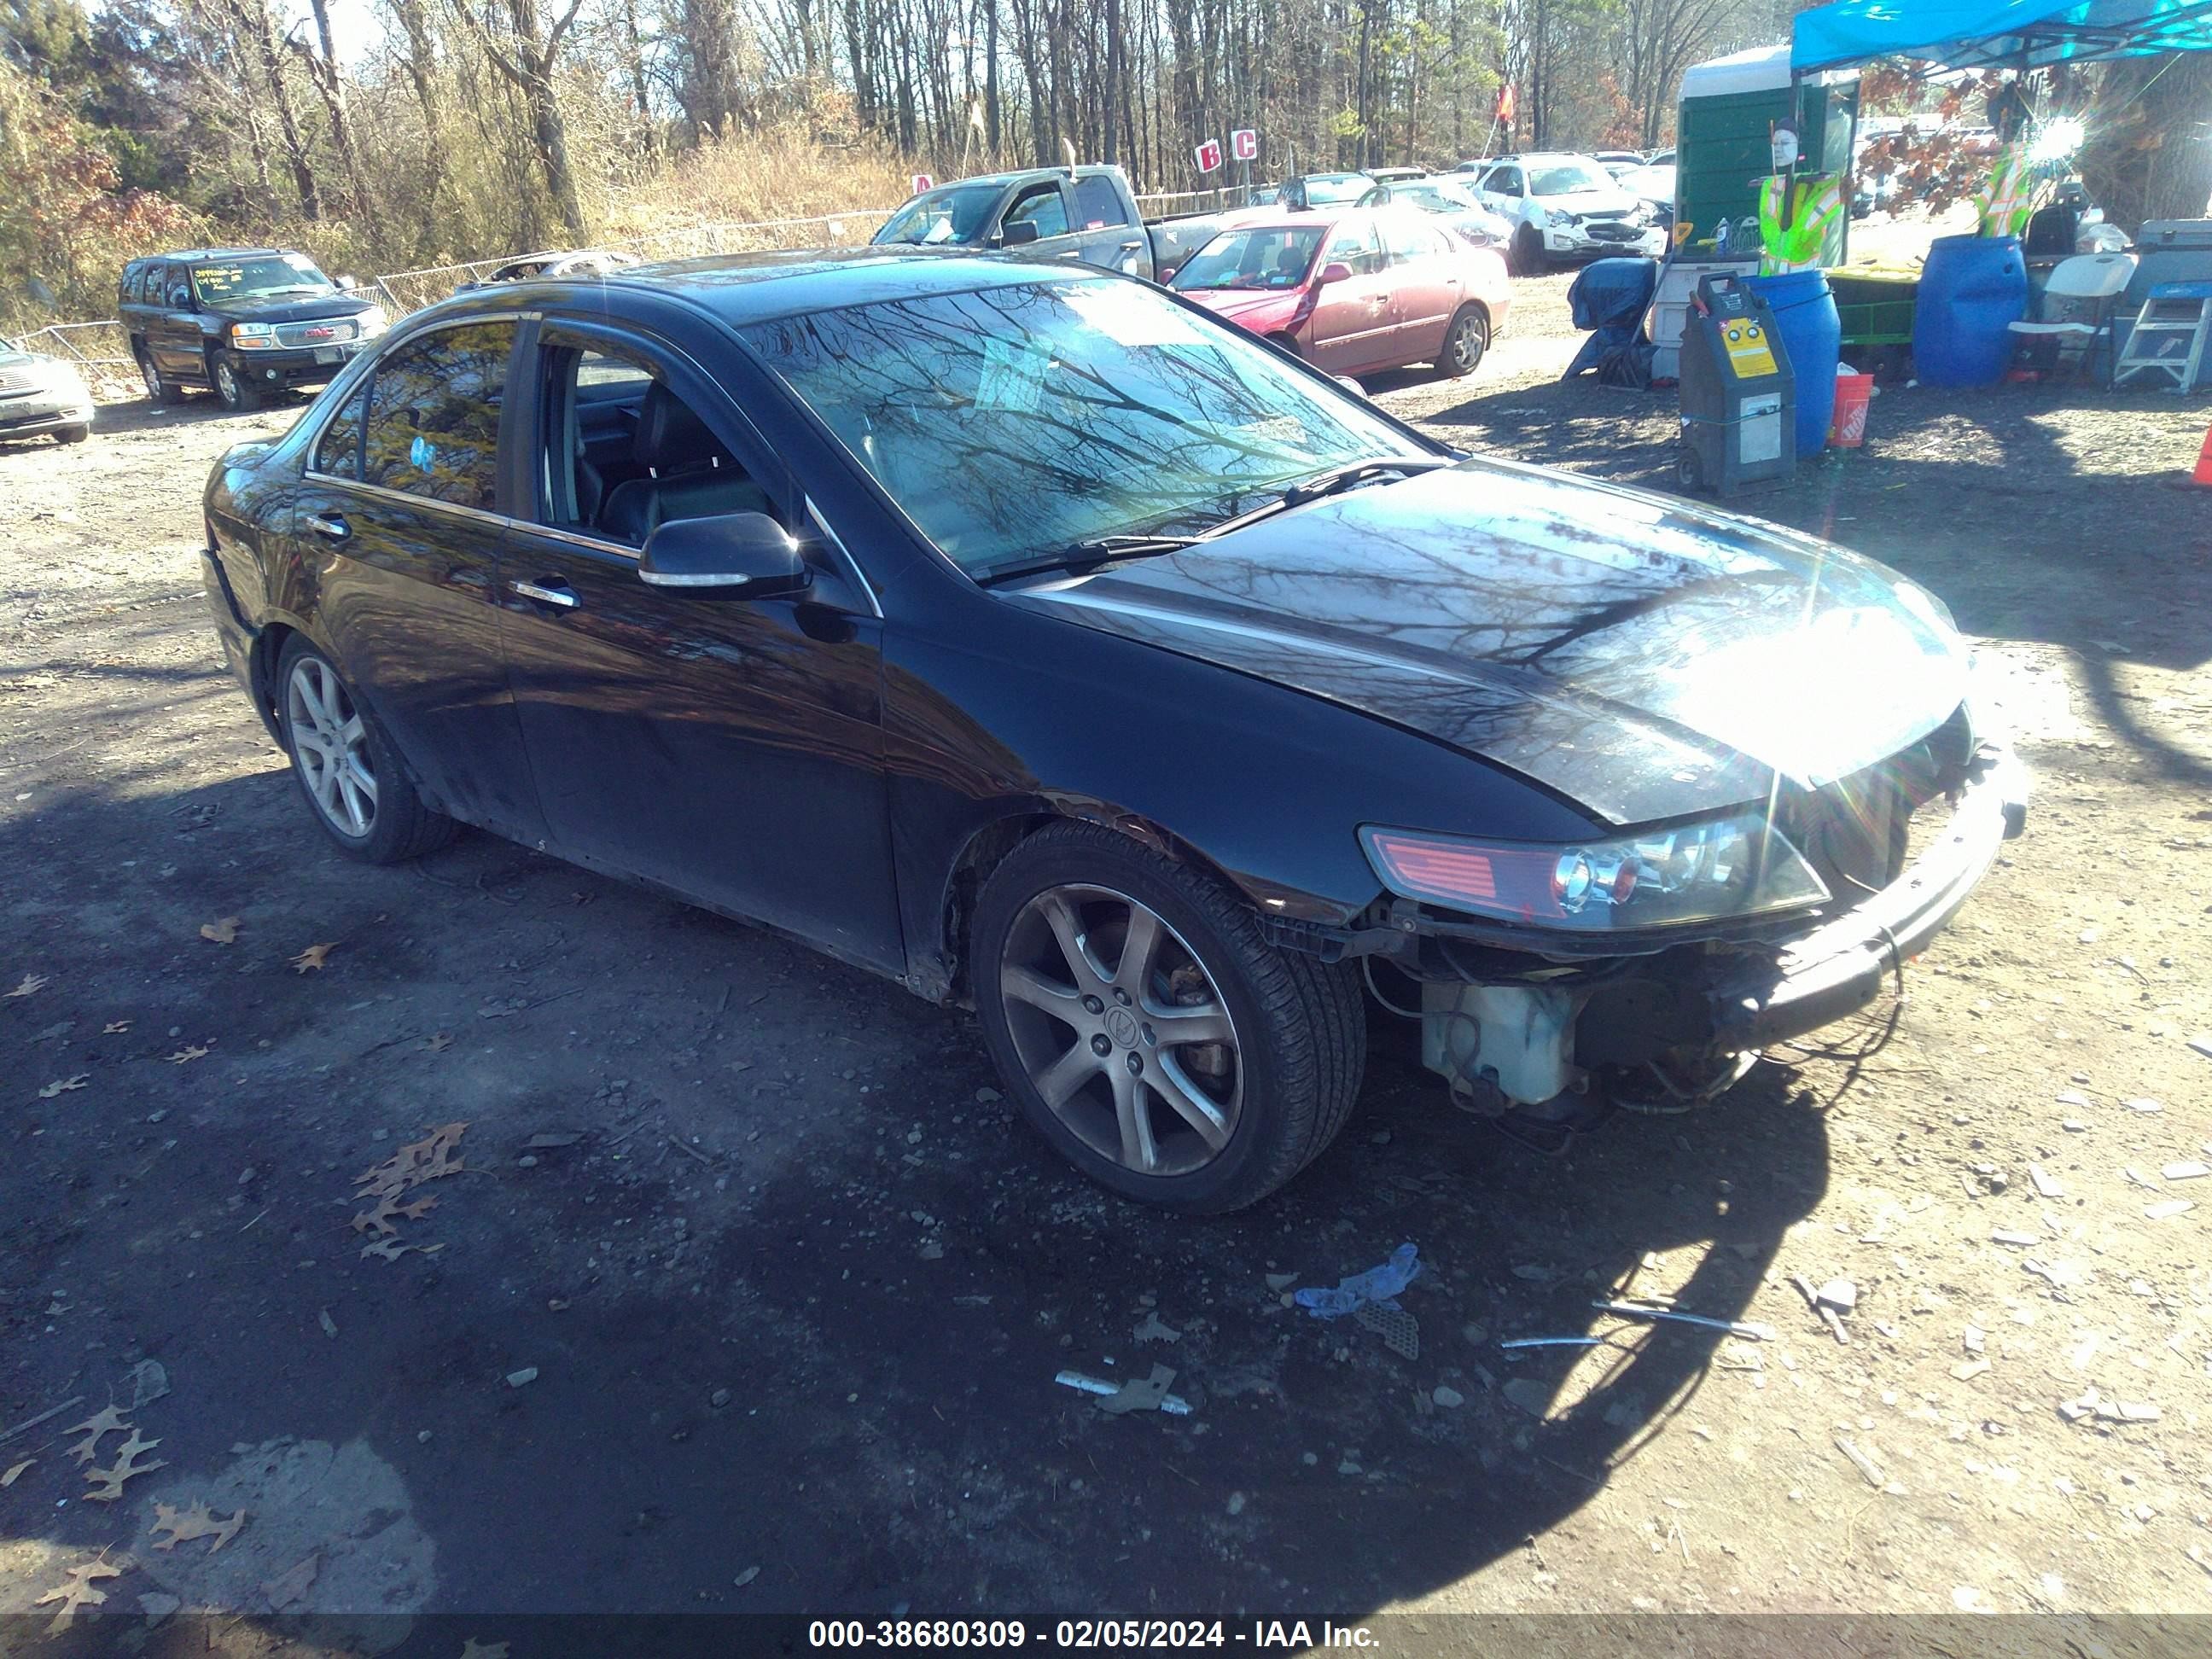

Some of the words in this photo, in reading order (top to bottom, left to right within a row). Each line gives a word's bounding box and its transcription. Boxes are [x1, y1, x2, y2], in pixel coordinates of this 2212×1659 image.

[1200, 143, 1220, 171] B
[1236, 131, 1255, 158] C
[917, 176, 930, 194] A
